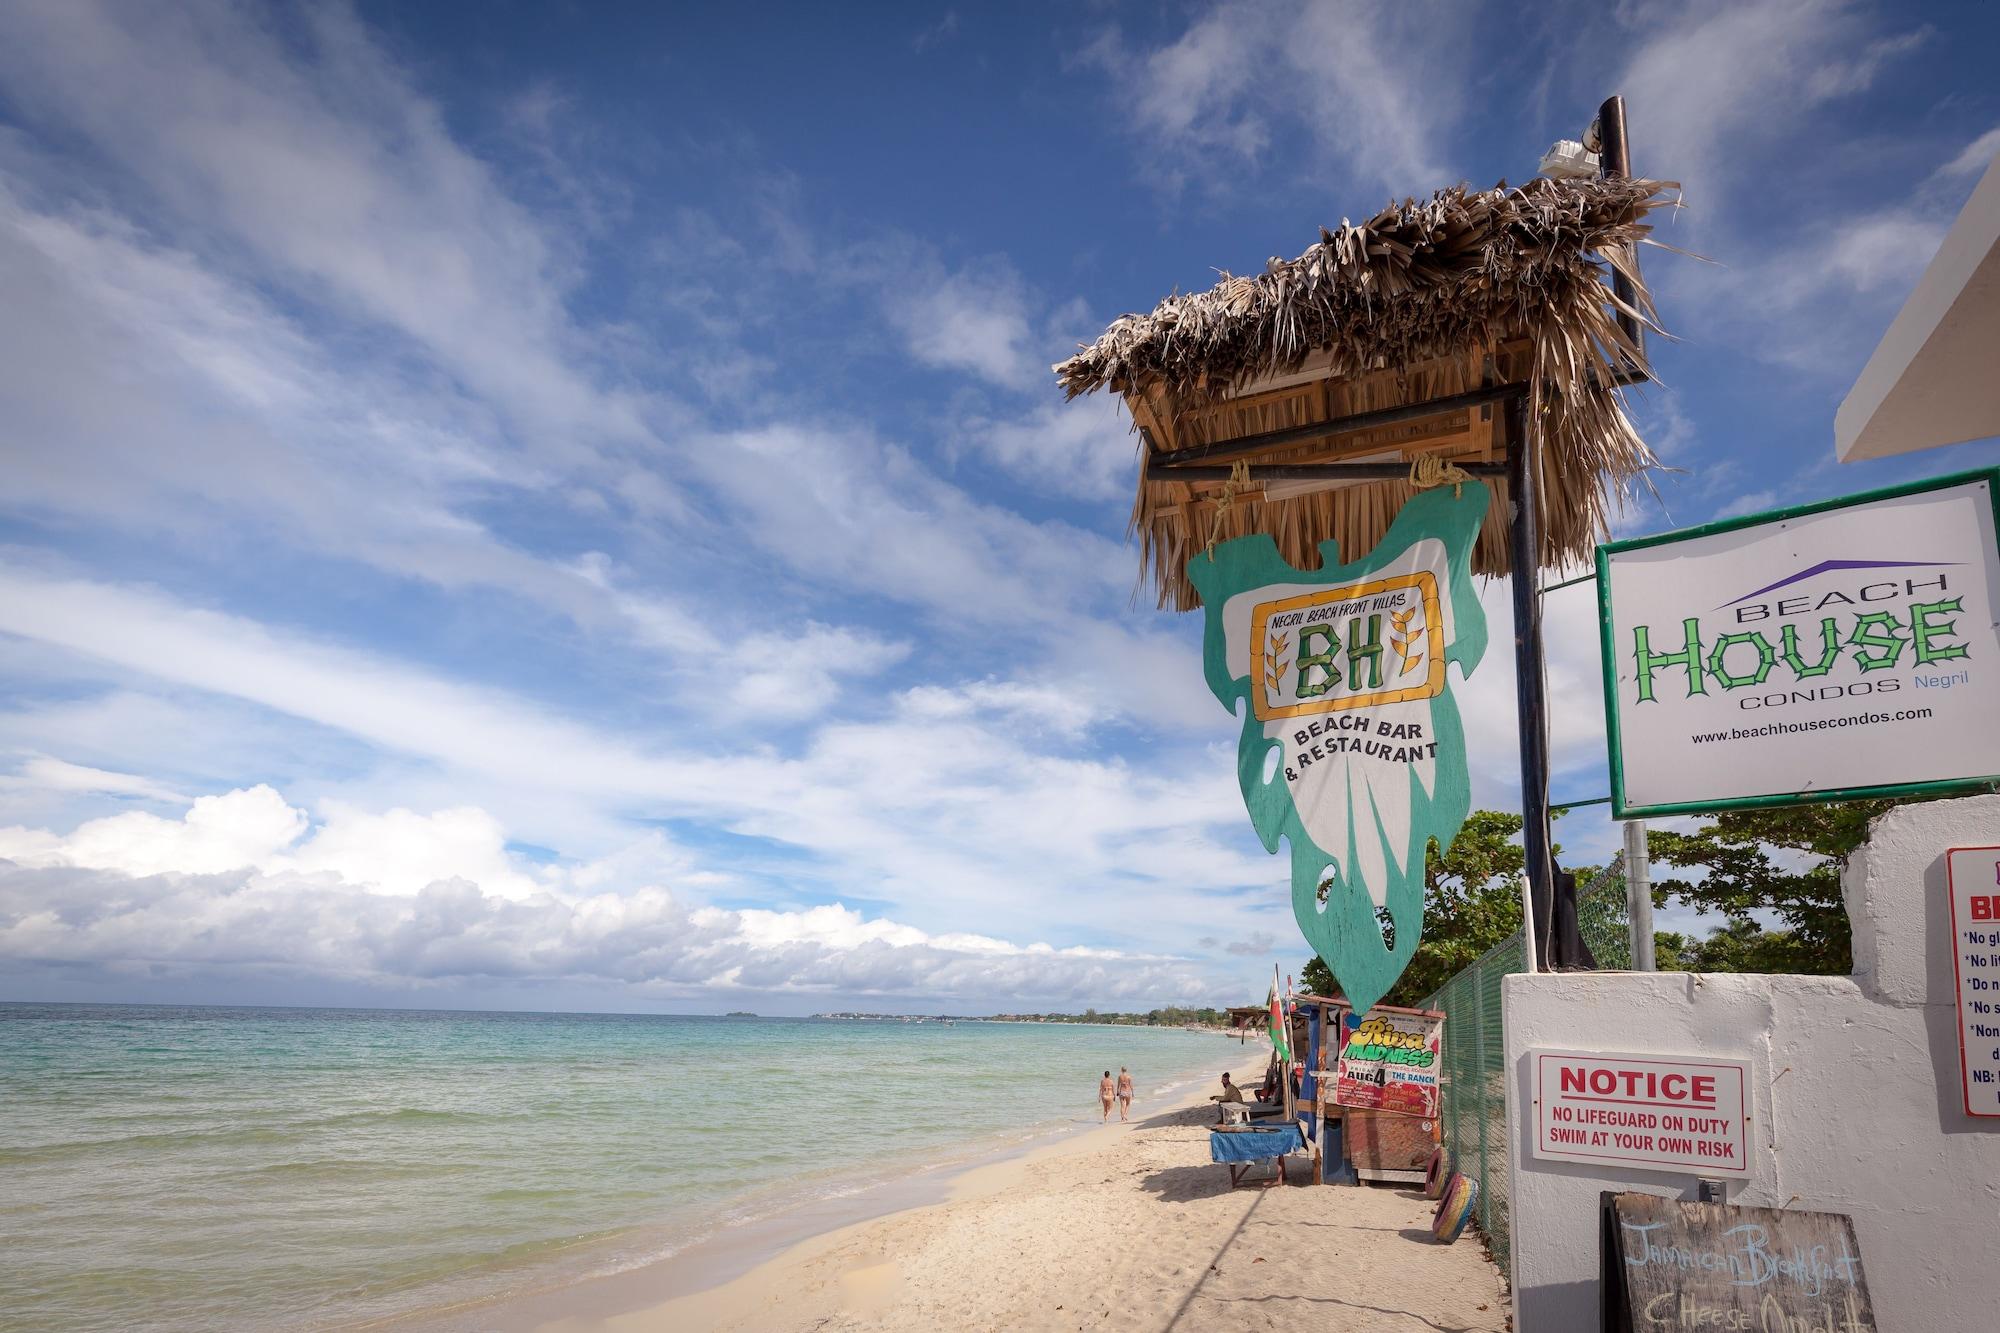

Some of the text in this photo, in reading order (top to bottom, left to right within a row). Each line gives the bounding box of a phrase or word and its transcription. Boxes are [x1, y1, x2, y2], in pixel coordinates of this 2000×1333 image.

[1271, 613, 1304, 629] NEGRIL
[1372, 593, 1406, 610] VILLAS
[1736, 574, 1947, 624] BEACH
[1296, 614, 1384, 698] BH
[1633, 595, 1971, 705] HOUSE
[1740, 671, 1969, 710] CONDOS Negril
[1294, 715, 1423, 746] BEACH BAR
[1692, 707, 1933, 744] www.beachhousecondos.com
[1285, 737, 1438, 782] & RESTAURANT
[1349, 1016, 1426, 1050] Riva
[1342, 1043, 1434, 1068] MADNESS
[1347, 1071, 1374, 1082] AUG
[1373, 1068, 1386, 1087] 4
[1392, 1071, 1406, 1080] THE
[1407, 1074, 1435, 1084] RANCH
[1561, 1067, 1716, 1103] NOTICE
[1553, 1106, 1730, 1136] NO LIFEGUARD ON DUTY
[1550, 1128, 1735, 1159] SWIM AT YOUR OWN RISK
